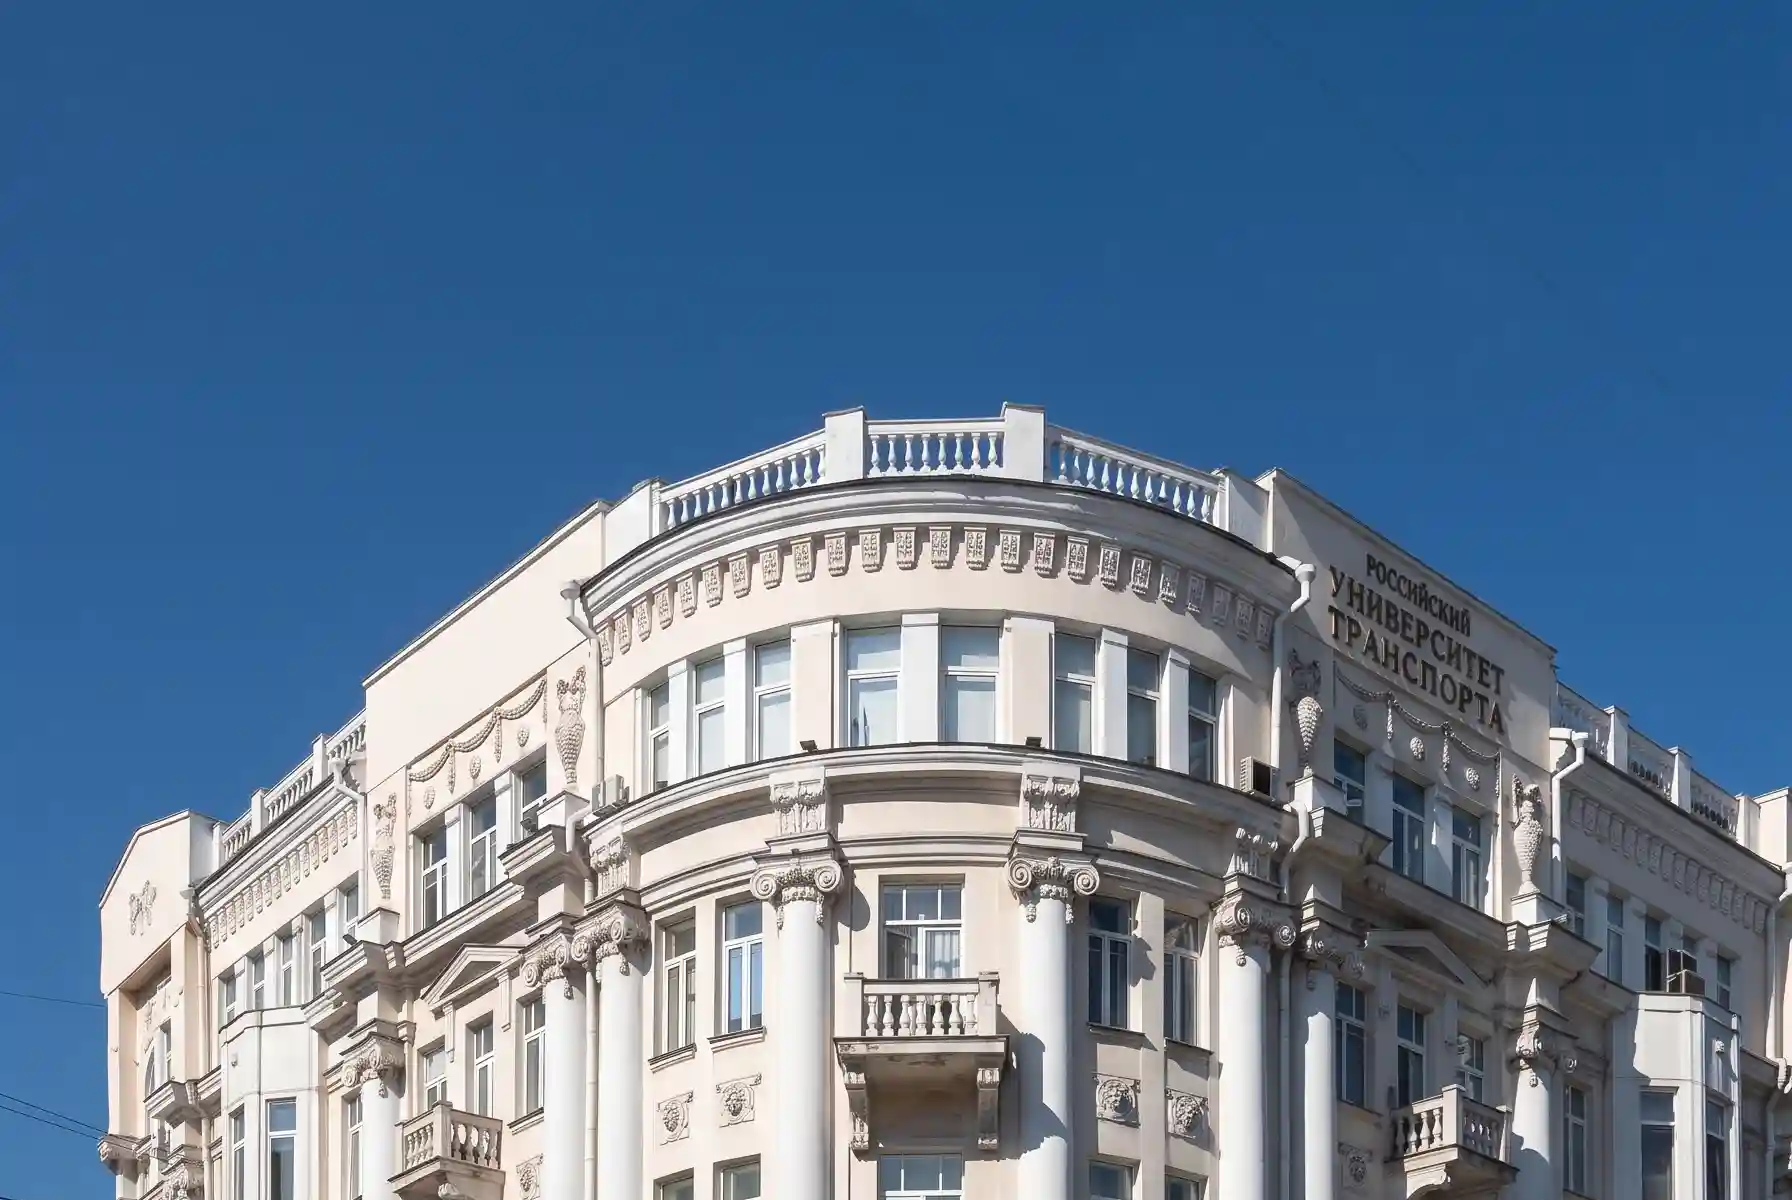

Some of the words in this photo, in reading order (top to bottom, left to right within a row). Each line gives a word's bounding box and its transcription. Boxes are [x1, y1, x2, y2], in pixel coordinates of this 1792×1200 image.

[1329, 564, 1505, 696] УНИВЕРСИТЕТ
[1366, 553, 1471, 637] РОССИЙСКИЙ
[1328, 604, 1505, 735] ТРАНСПОРТА
